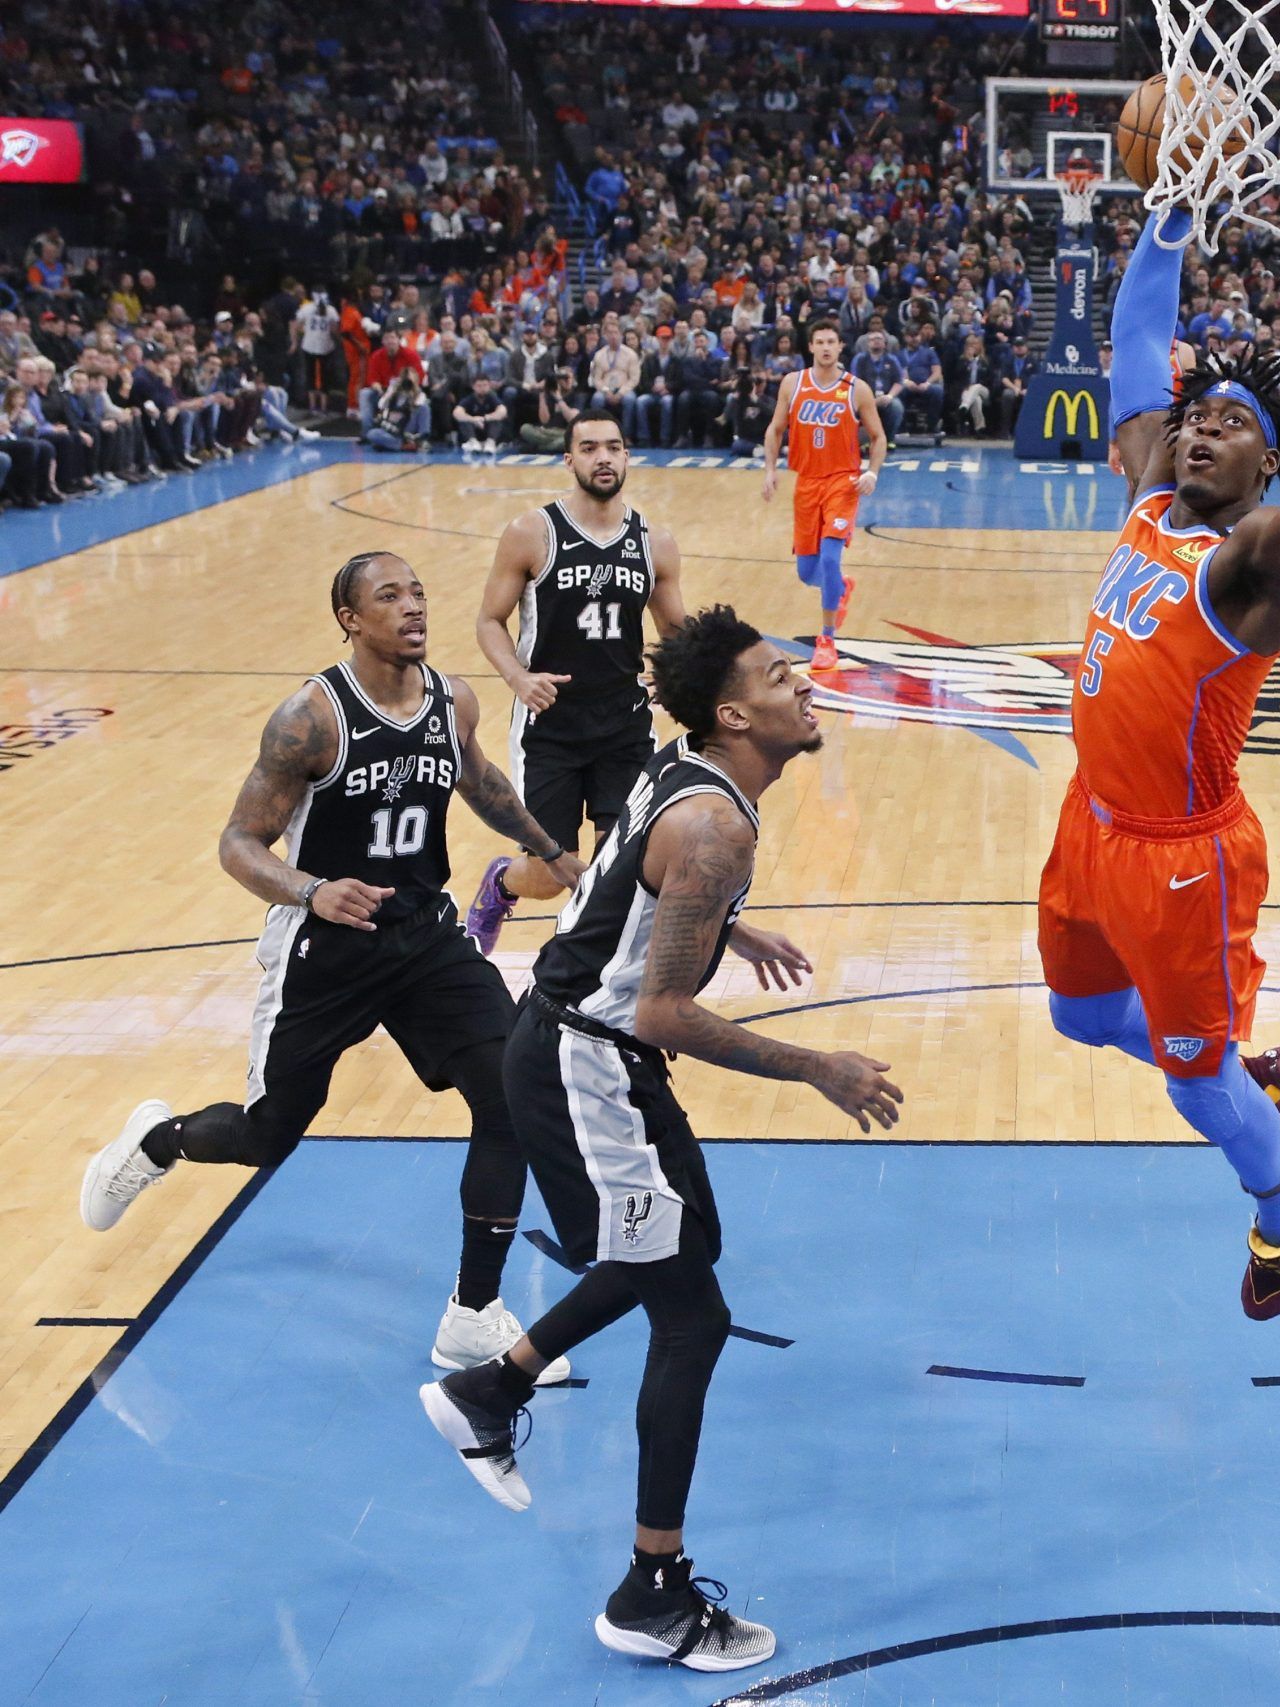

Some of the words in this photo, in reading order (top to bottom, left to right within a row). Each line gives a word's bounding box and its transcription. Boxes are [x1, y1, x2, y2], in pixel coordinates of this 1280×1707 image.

[1065, 25, 1119, 39] TISSOT
[1070, 268, 1087, 320] devon
[1045, 362, 1098, 376] Medicine
[798, 398, 847, 427] OKC
[813, 427, 826, 449] 8
[621, 549, 641, 559] Frost
[1093, 543, 1190, 641] OKC
[577, 601, 622, 640] 41
[1080, 629, 1115, 697] 5
[424, 732, 447, 744] Frost
[367, 805, 429, 858] 10
